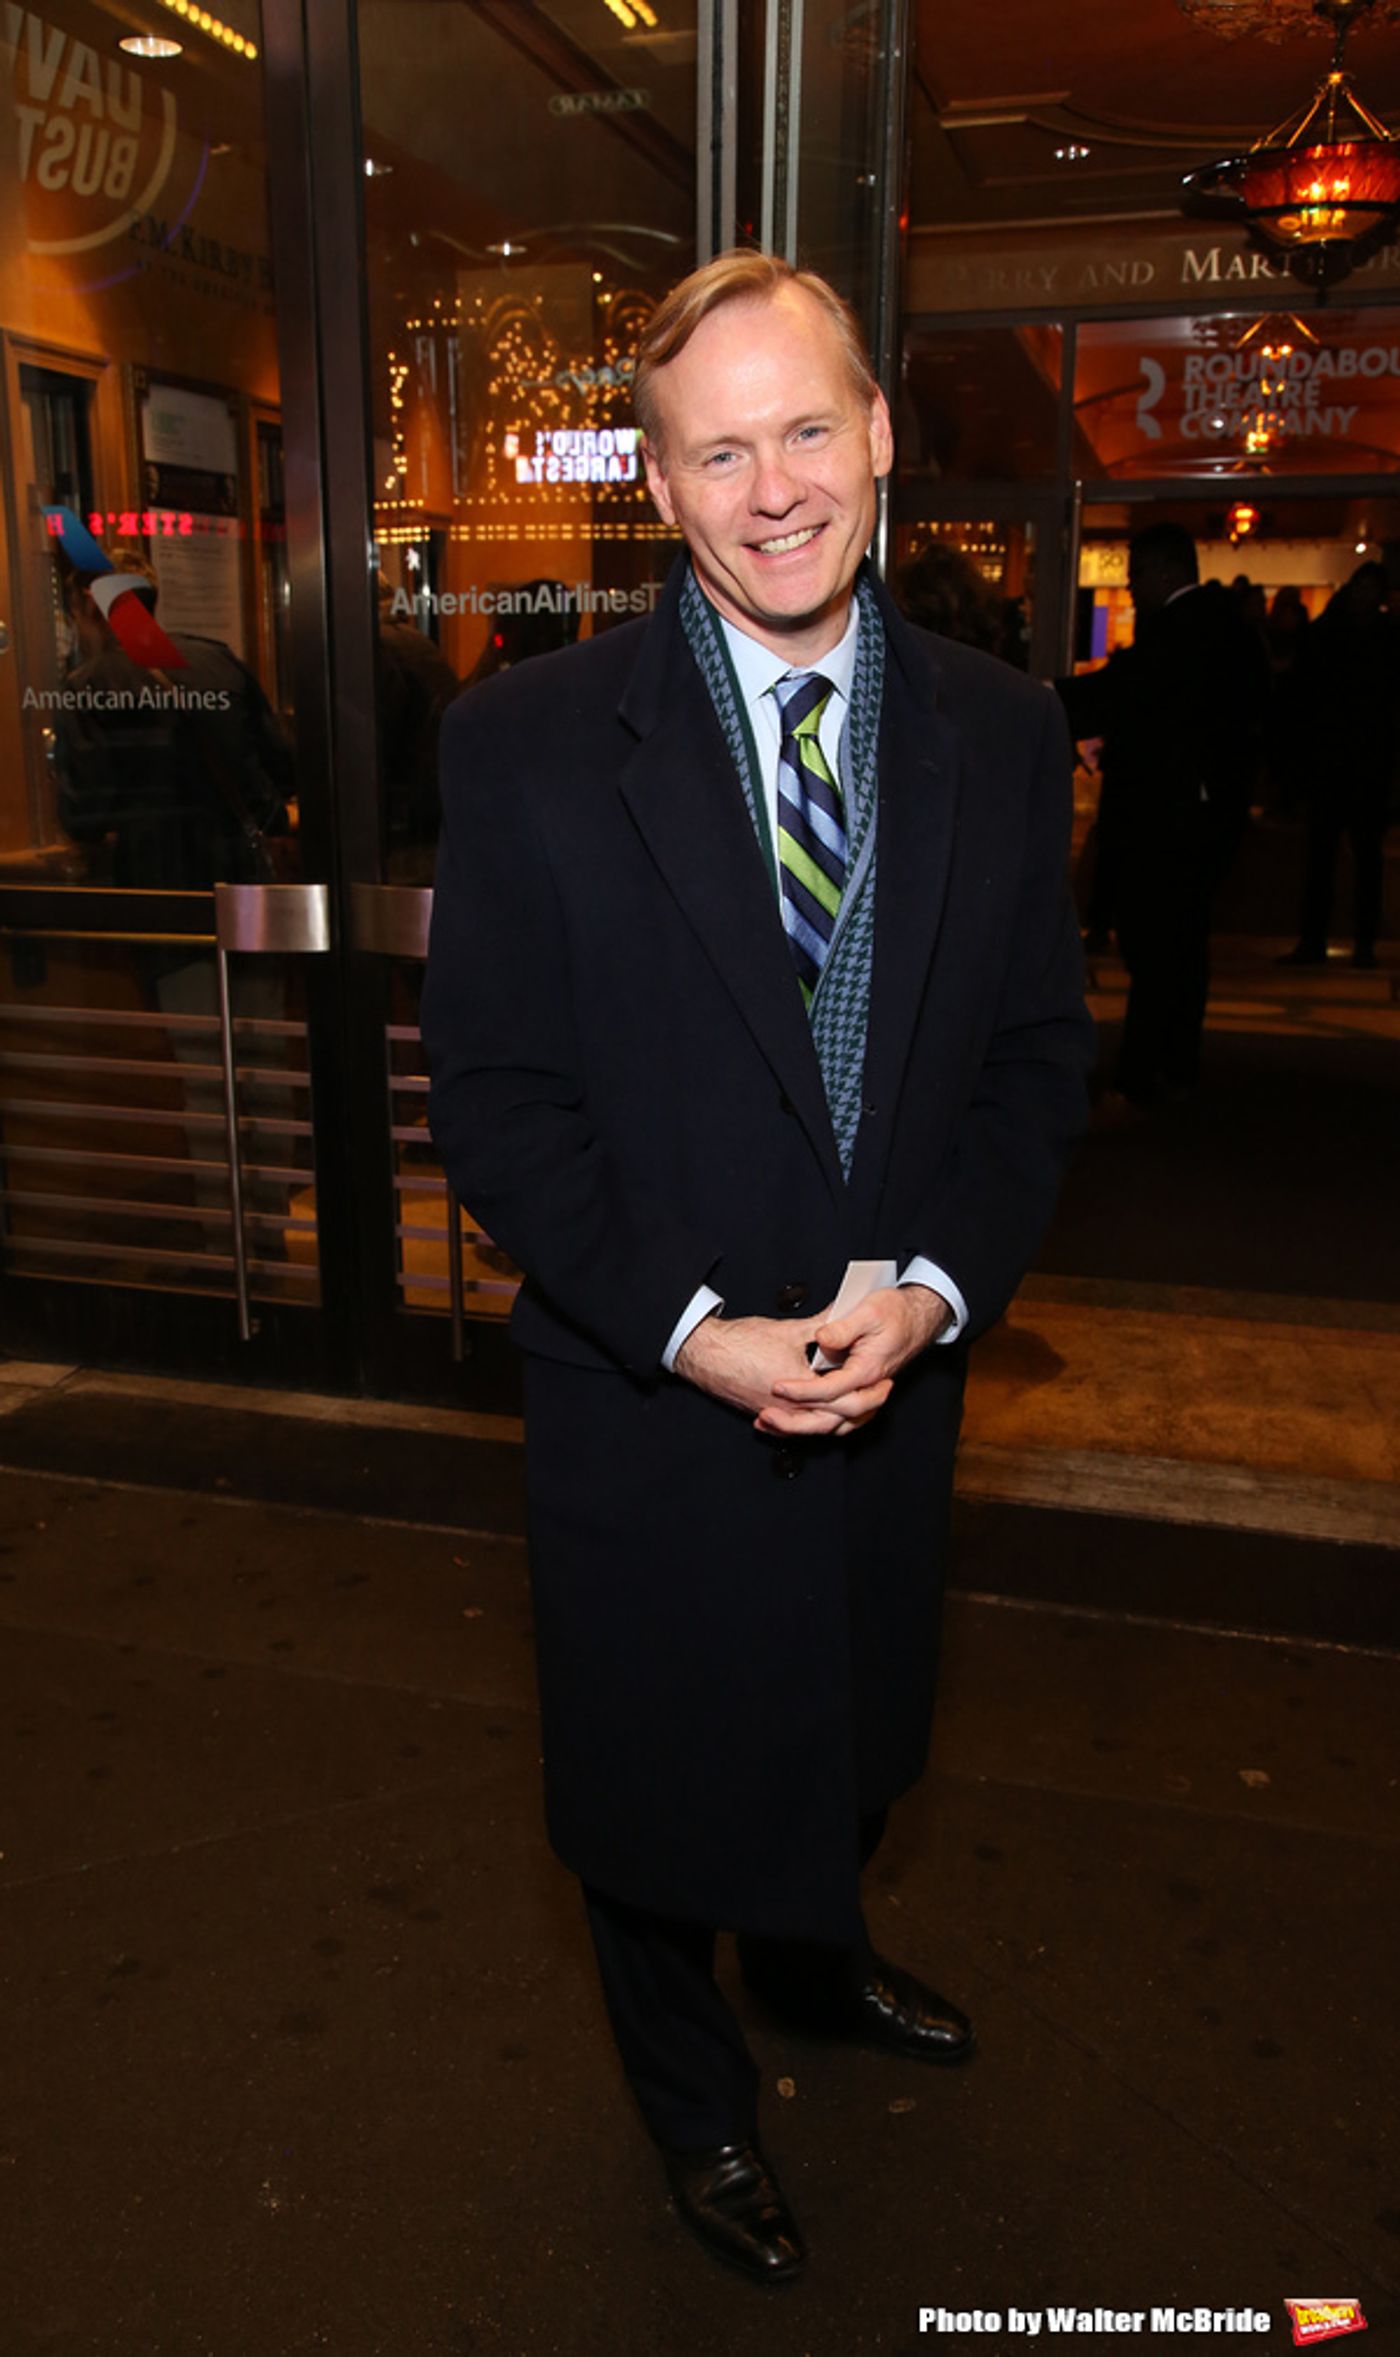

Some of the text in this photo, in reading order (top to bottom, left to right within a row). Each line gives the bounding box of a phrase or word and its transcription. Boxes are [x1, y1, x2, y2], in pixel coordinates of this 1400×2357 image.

[1079, 261, 1155, 288] AND
[1183, 379, 1321, 409] THEATRE
[1180, 406, 1358, 439] COMPANY
[22, 684, 231, 710] American Airlines
